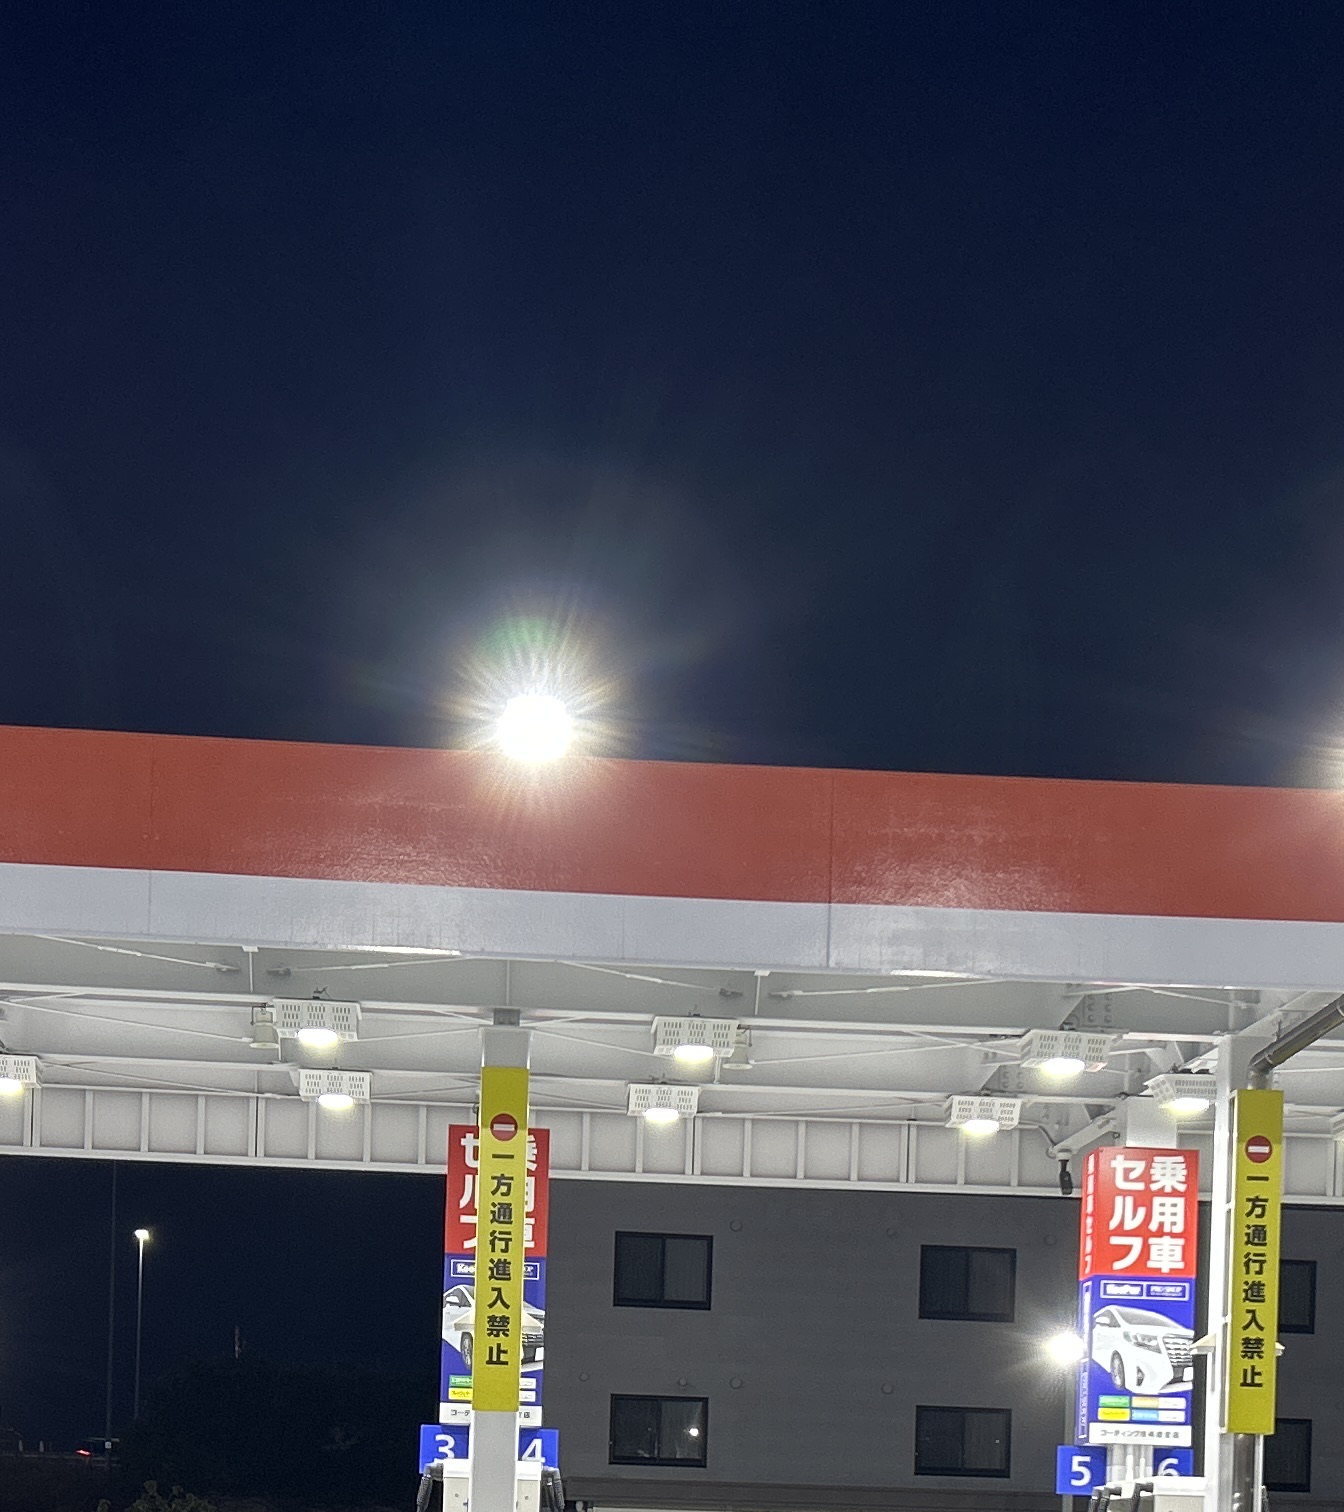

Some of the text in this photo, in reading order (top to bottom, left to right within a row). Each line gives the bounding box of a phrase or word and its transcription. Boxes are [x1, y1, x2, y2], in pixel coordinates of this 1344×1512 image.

[1108, 1154, 1146, 1271] セルフ
[1146, 1154, 1188, 1274] 乗用車
[485, 1153, 515, 1367] 一方通行進入禁止
[1239, 1175, 1270, 1388] 一方通行進入禁止
[434, 1433, 455, 1459] 3
[521, 1438, 546, 1462] 4
[1068, 1455, 1092, 1487] 5
[1157, 1456, 1179, 1477] 6
